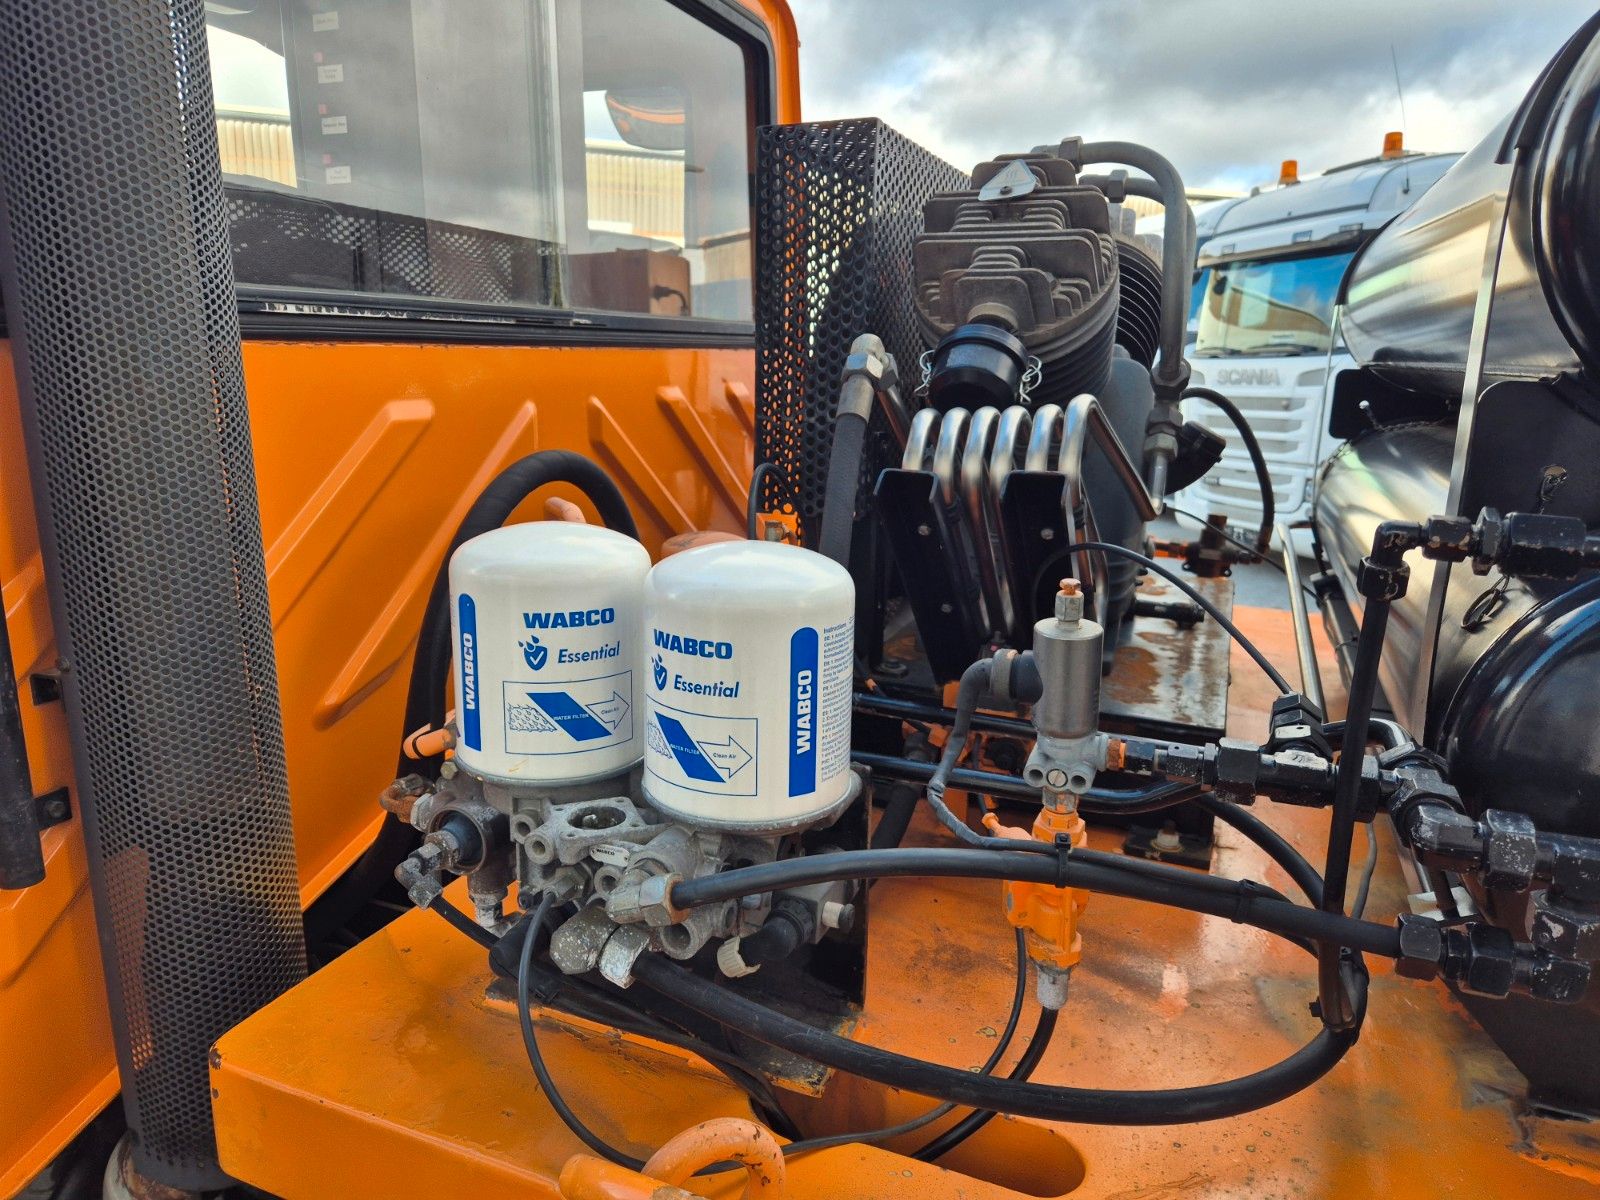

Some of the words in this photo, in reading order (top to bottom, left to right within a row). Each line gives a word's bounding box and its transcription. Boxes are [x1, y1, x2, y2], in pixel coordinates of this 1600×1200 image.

[1217, 367, 1280, 386] SCANIA
[523, 608, 615, 629] WABCO
[558, 640, 620, 664] Essential
[654, 629, 733, 660] WABCO
[463, 632, 475, 710] WABCO
[674, 674, 740, 698] Essential
[797, 669, 812, 755] WABCO
